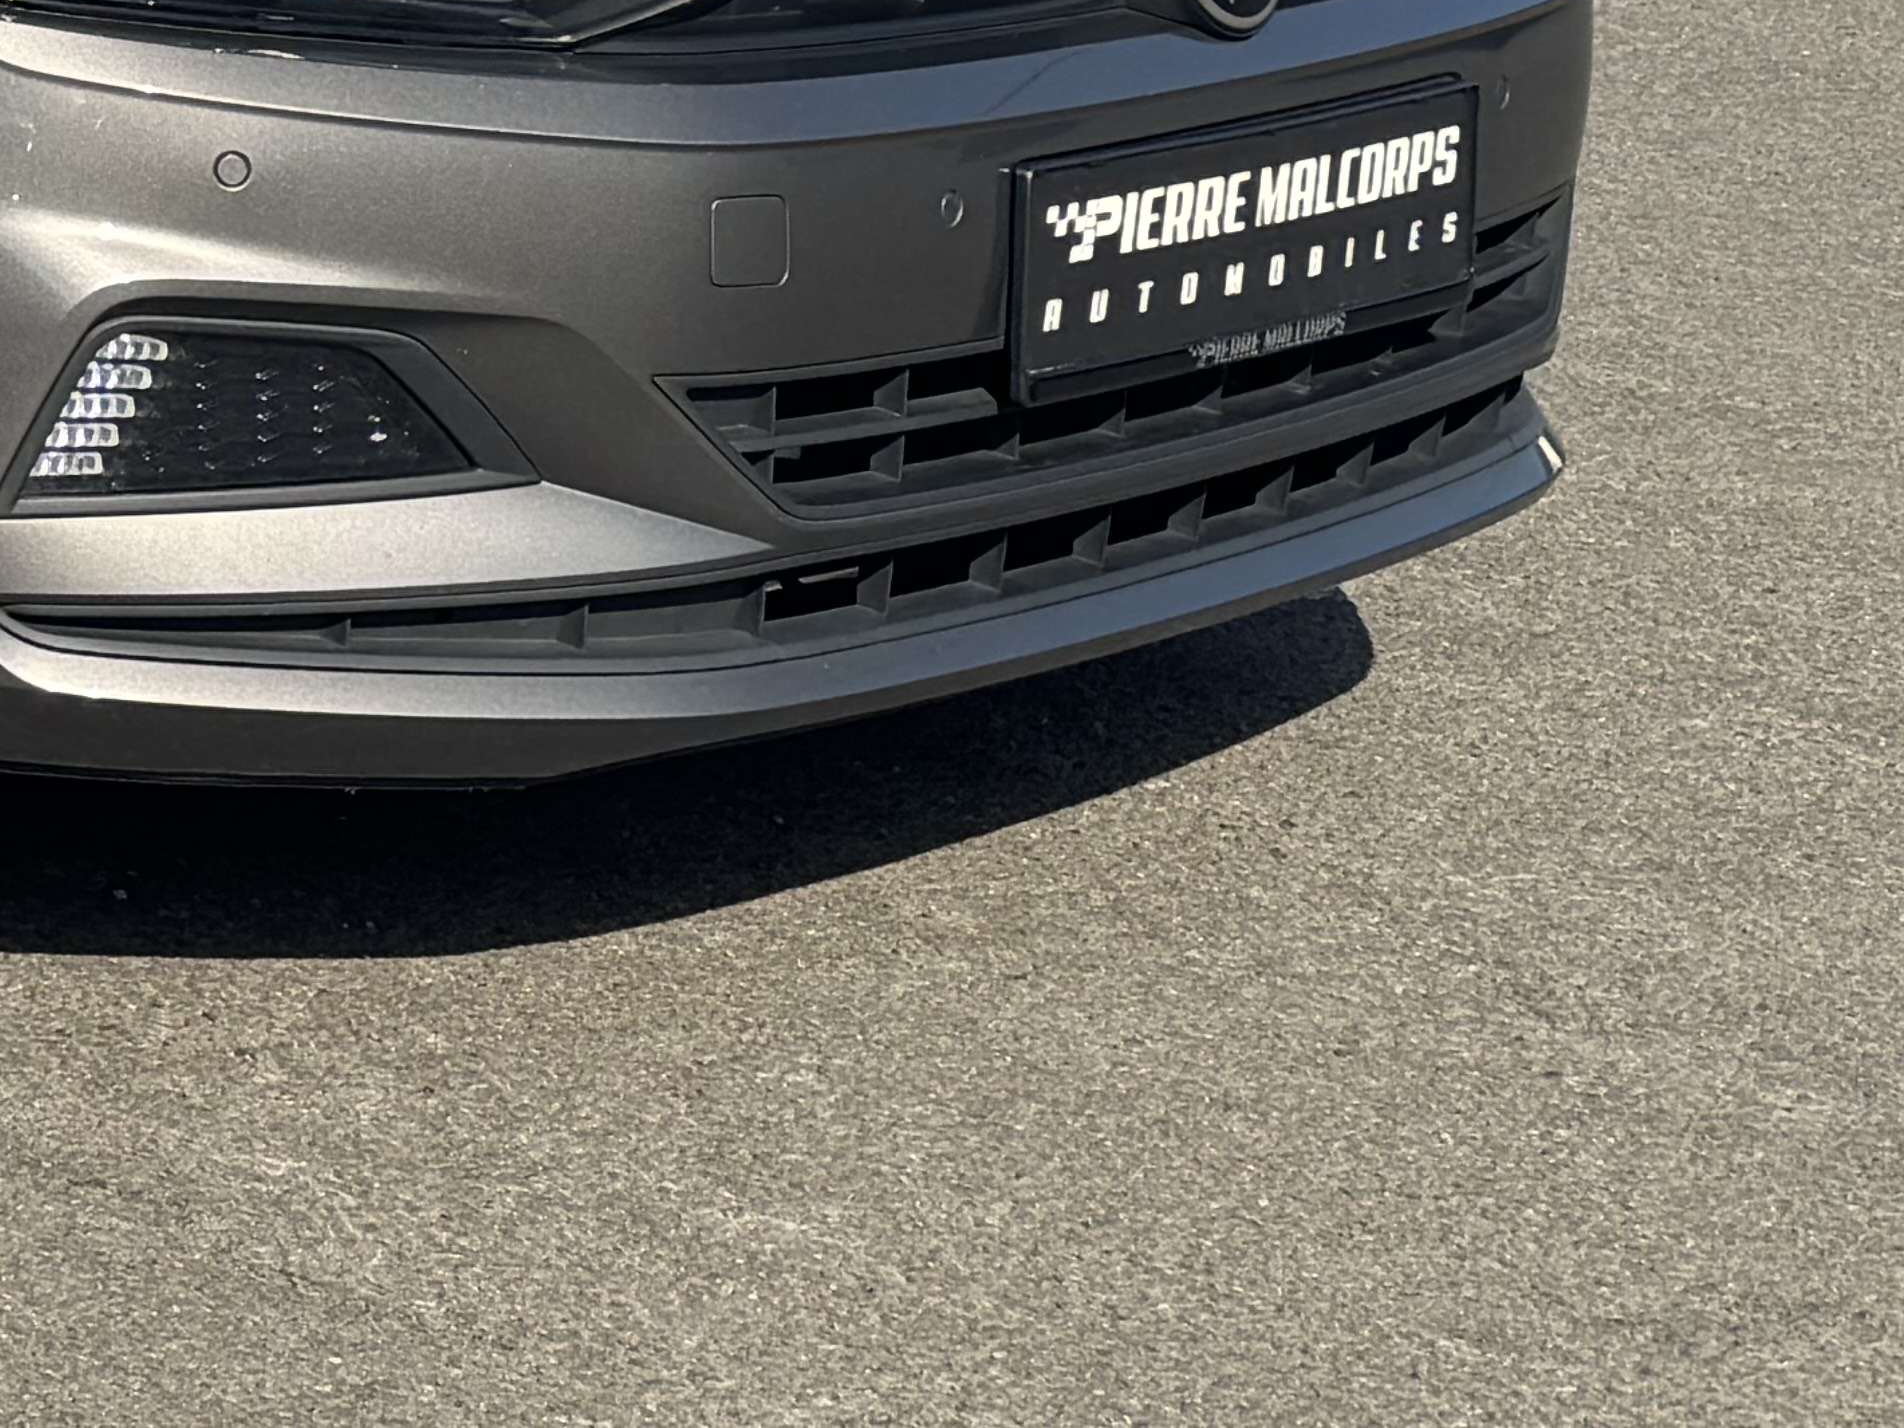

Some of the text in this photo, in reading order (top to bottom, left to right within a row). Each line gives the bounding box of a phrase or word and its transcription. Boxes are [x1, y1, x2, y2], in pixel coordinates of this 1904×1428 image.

[1068, 124, 1460, 263] PIERRE MALCORPS
[1042, 211, 1459, 332] AUTOMOBILES
